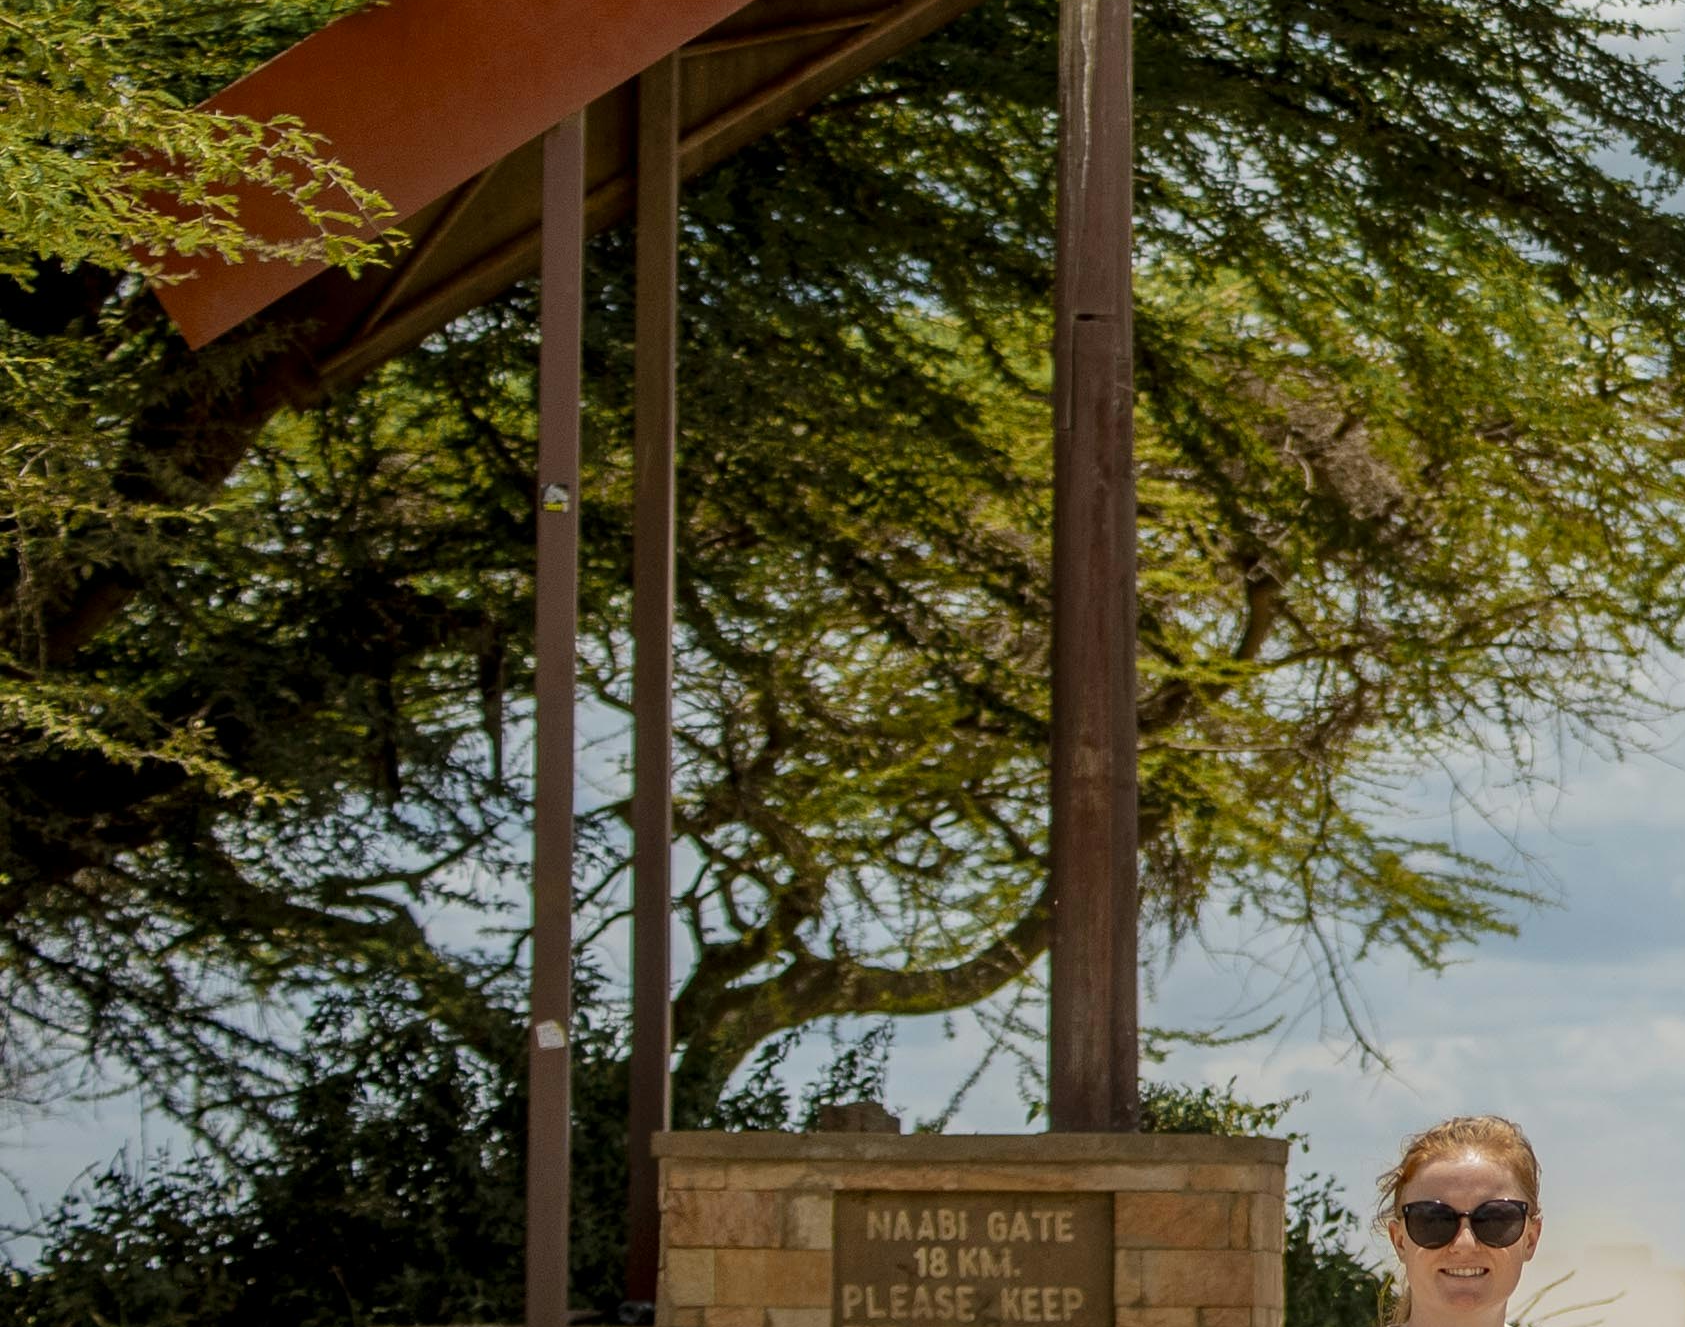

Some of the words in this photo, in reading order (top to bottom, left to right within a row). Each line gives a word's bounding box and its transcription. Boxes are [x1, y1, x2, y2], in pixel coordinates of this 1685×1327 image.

[866, 1209, 968, 1242] NAABI
[986, 1210, 1075, 1243] GATE
[913, 1247, 949, 1278] 18
[841, 1284, 976, 1322] PLEASE
[1000, 1286, 1084, 1322] KEEP
